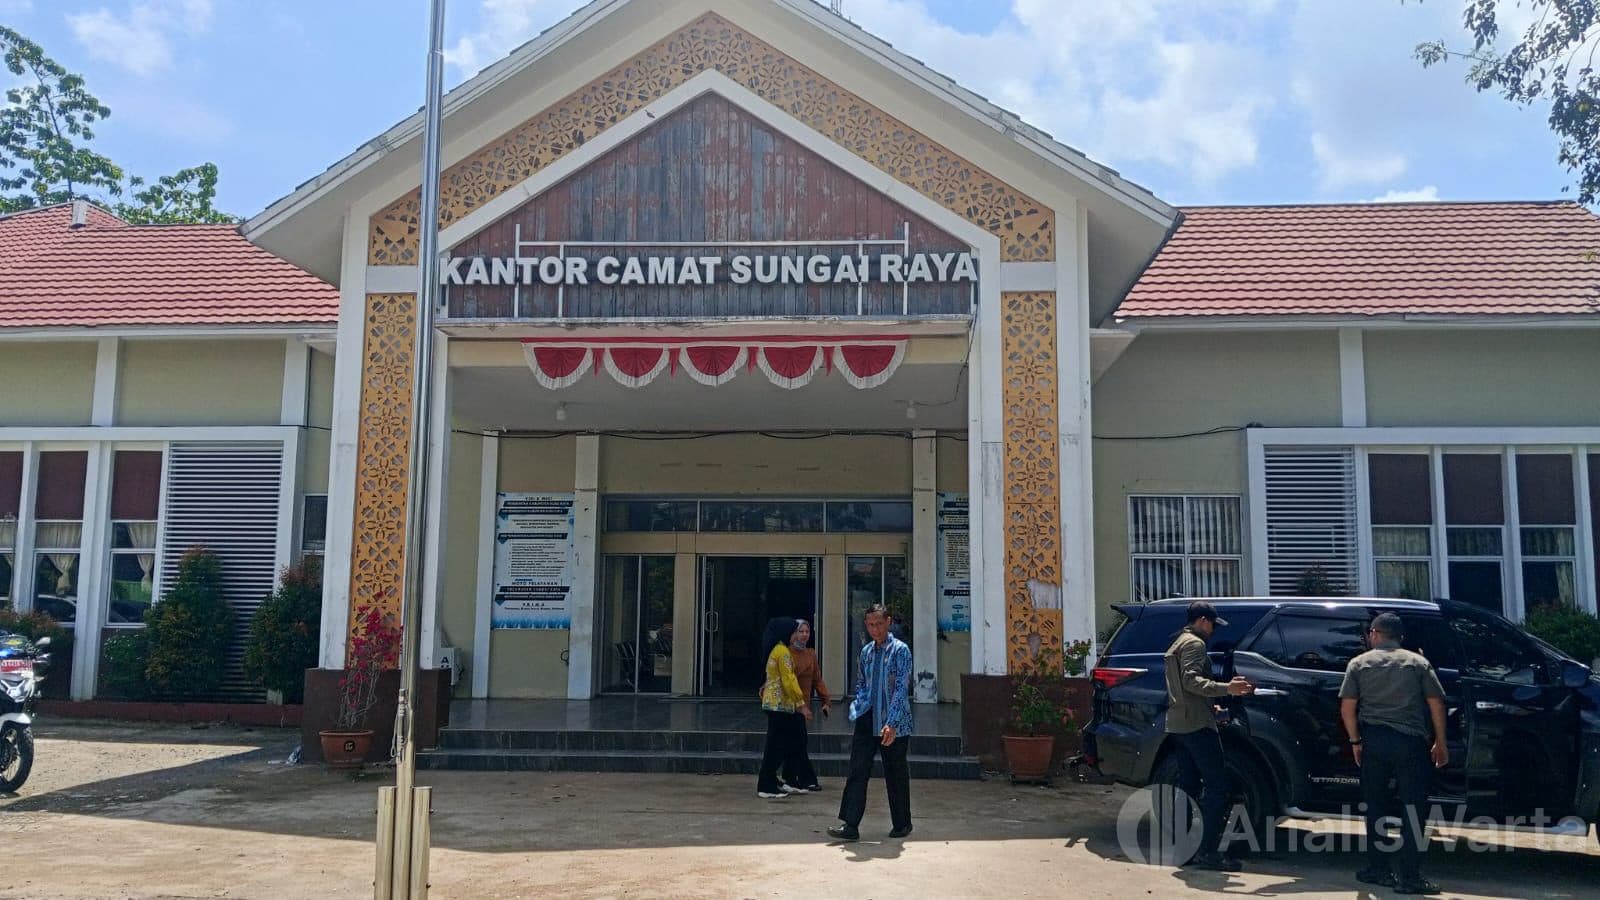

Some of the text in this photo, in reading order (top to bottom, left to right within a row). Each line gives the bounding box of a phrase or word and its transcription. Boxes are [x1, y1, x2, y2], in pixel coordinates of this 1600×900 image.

[440, 252, 978, 285] KANTOR CAMAT SUNGAI RAYA
